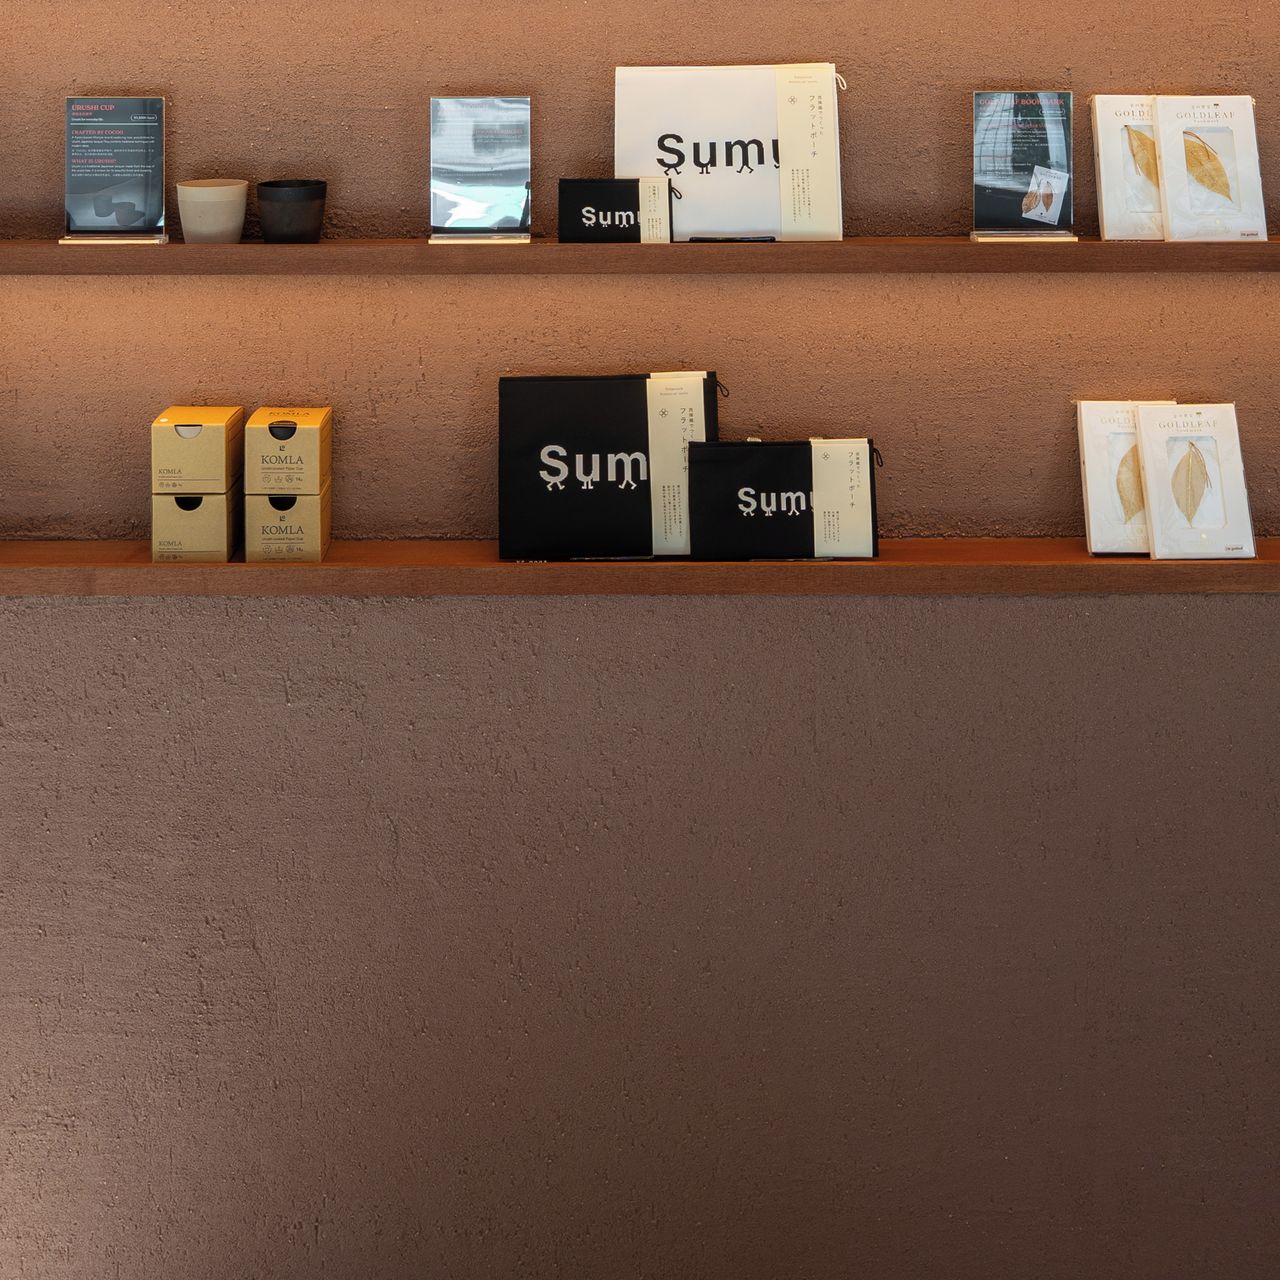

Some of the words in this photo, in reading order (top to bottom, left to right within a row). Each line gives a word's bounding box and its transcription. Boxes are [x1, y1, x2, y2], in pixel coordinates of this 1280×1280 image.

[809, 95, 818, 159] フラットポーチ
[1176, 111, 1235, 119] GOLDLEAF
[656, 133, 780, 176] Sum
[581, 206, 640, 228] Sum
[1158, 421, 1217, 429] GOLDLEAF
[680, 407, 689, 473] フラットポーチ
[261, 455, 304, 465] KOMLA
[847, 451, 856, 509] フラットポーチ
[737, 486, 814, 517] Sum
[261, 525, 305, 535] KOMLA
